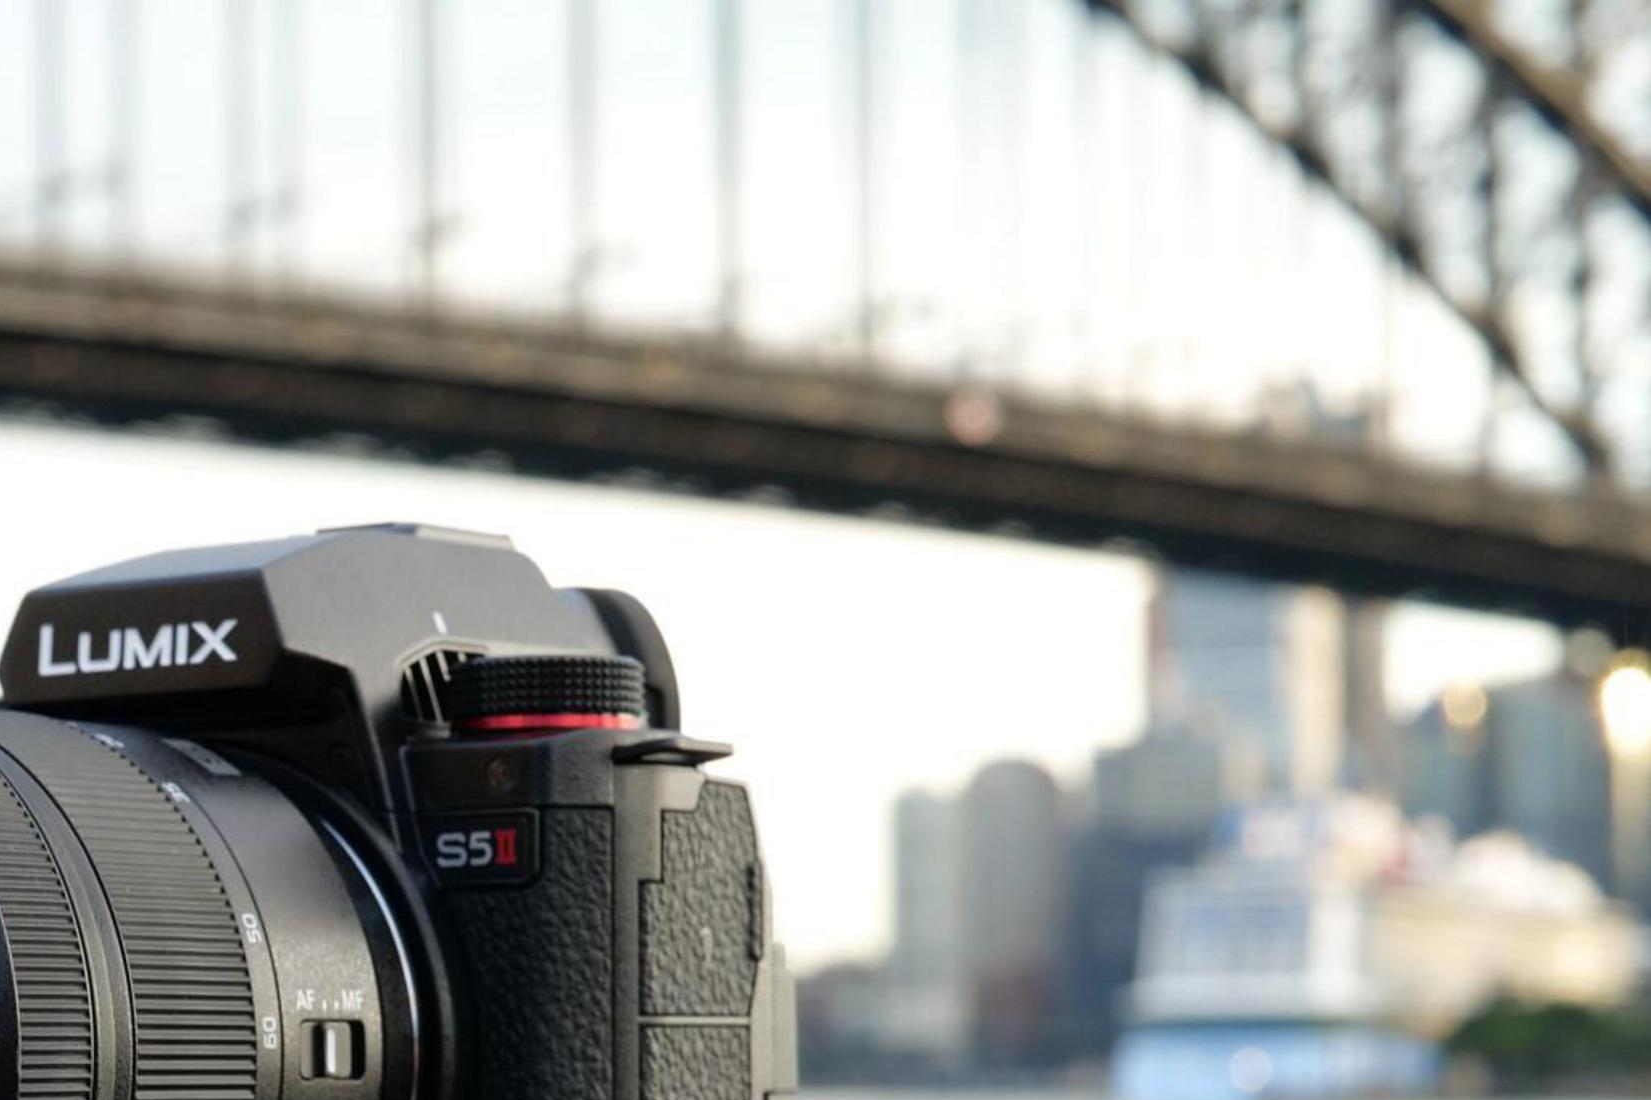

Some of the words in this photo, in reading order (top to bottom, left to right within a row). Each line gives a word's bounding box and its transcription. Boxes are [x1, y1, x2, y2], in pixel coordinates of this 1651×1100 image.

[37, 619, 238, 677] LUMIX
[241, 912, 263, 944] 50
[295, 988, 316, 1011] AF
[340, 988, 363, 1011] MF
[262, 1014, 278, 1049] 60
